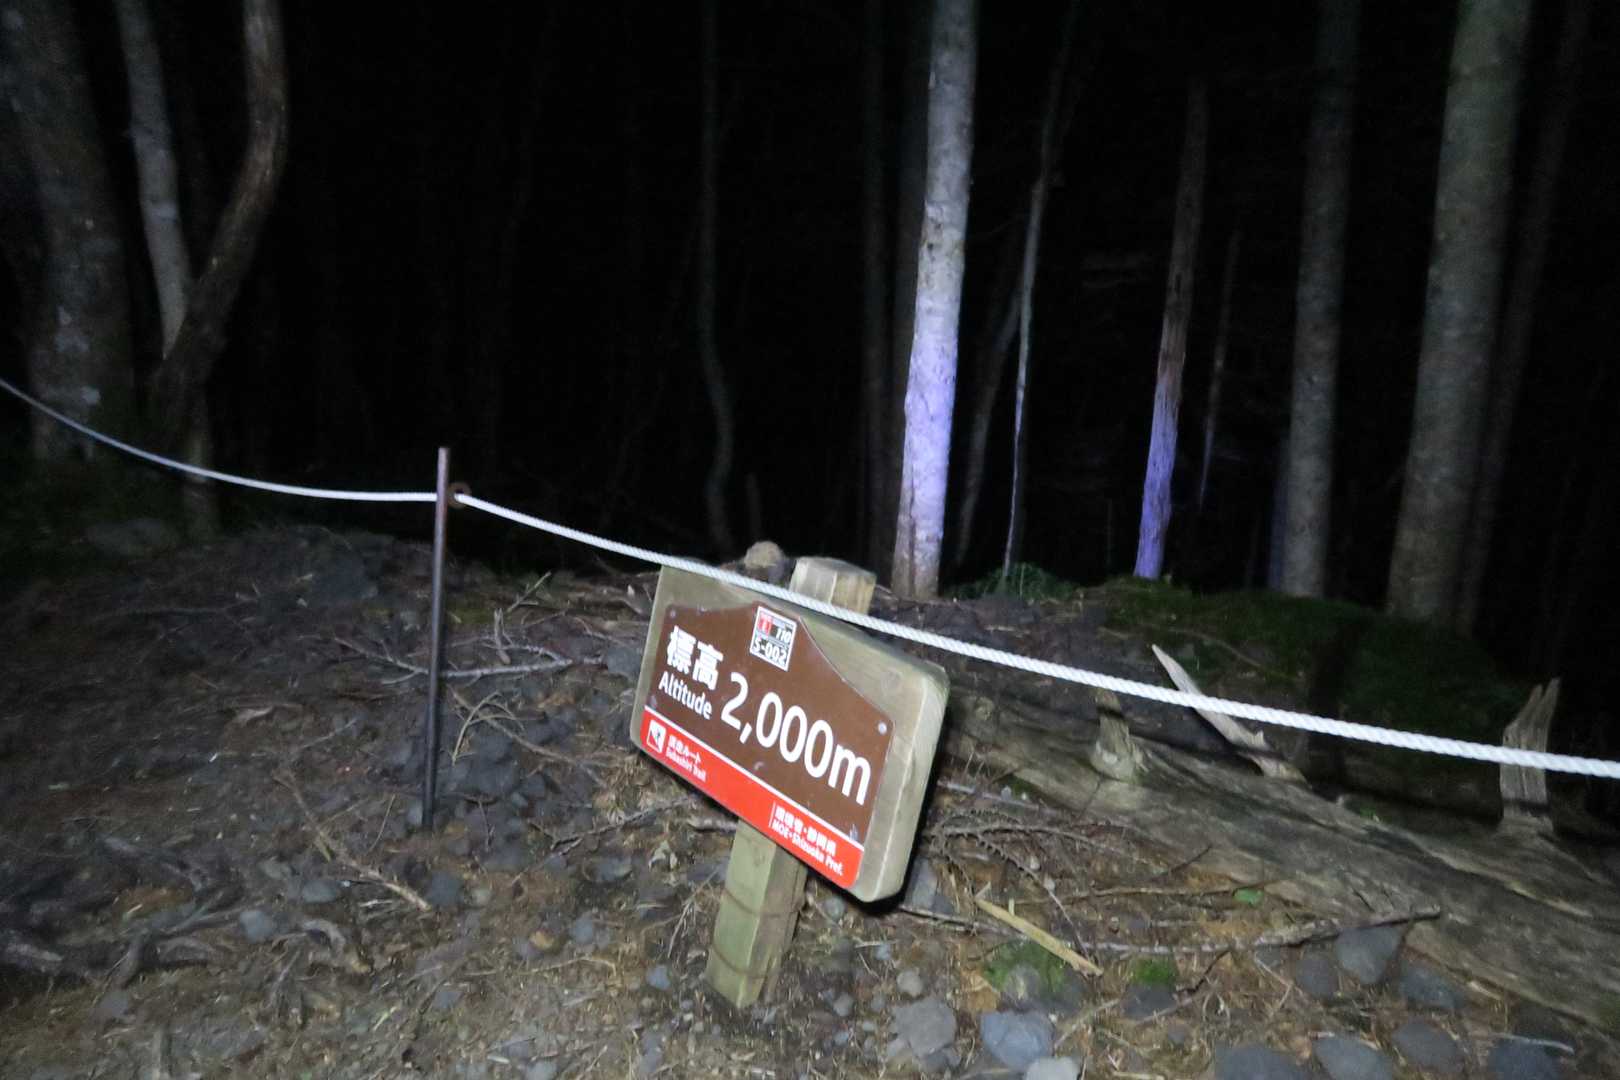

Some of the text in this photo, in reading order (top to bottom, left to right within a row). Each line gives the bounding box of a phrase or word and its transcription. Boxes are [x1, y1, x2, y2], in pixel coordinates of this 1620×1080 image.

[666, 625, 723, 690] 標高
[658, 670, 712, 720] Altitude
[720, 672, 871, 805] 2,000m
